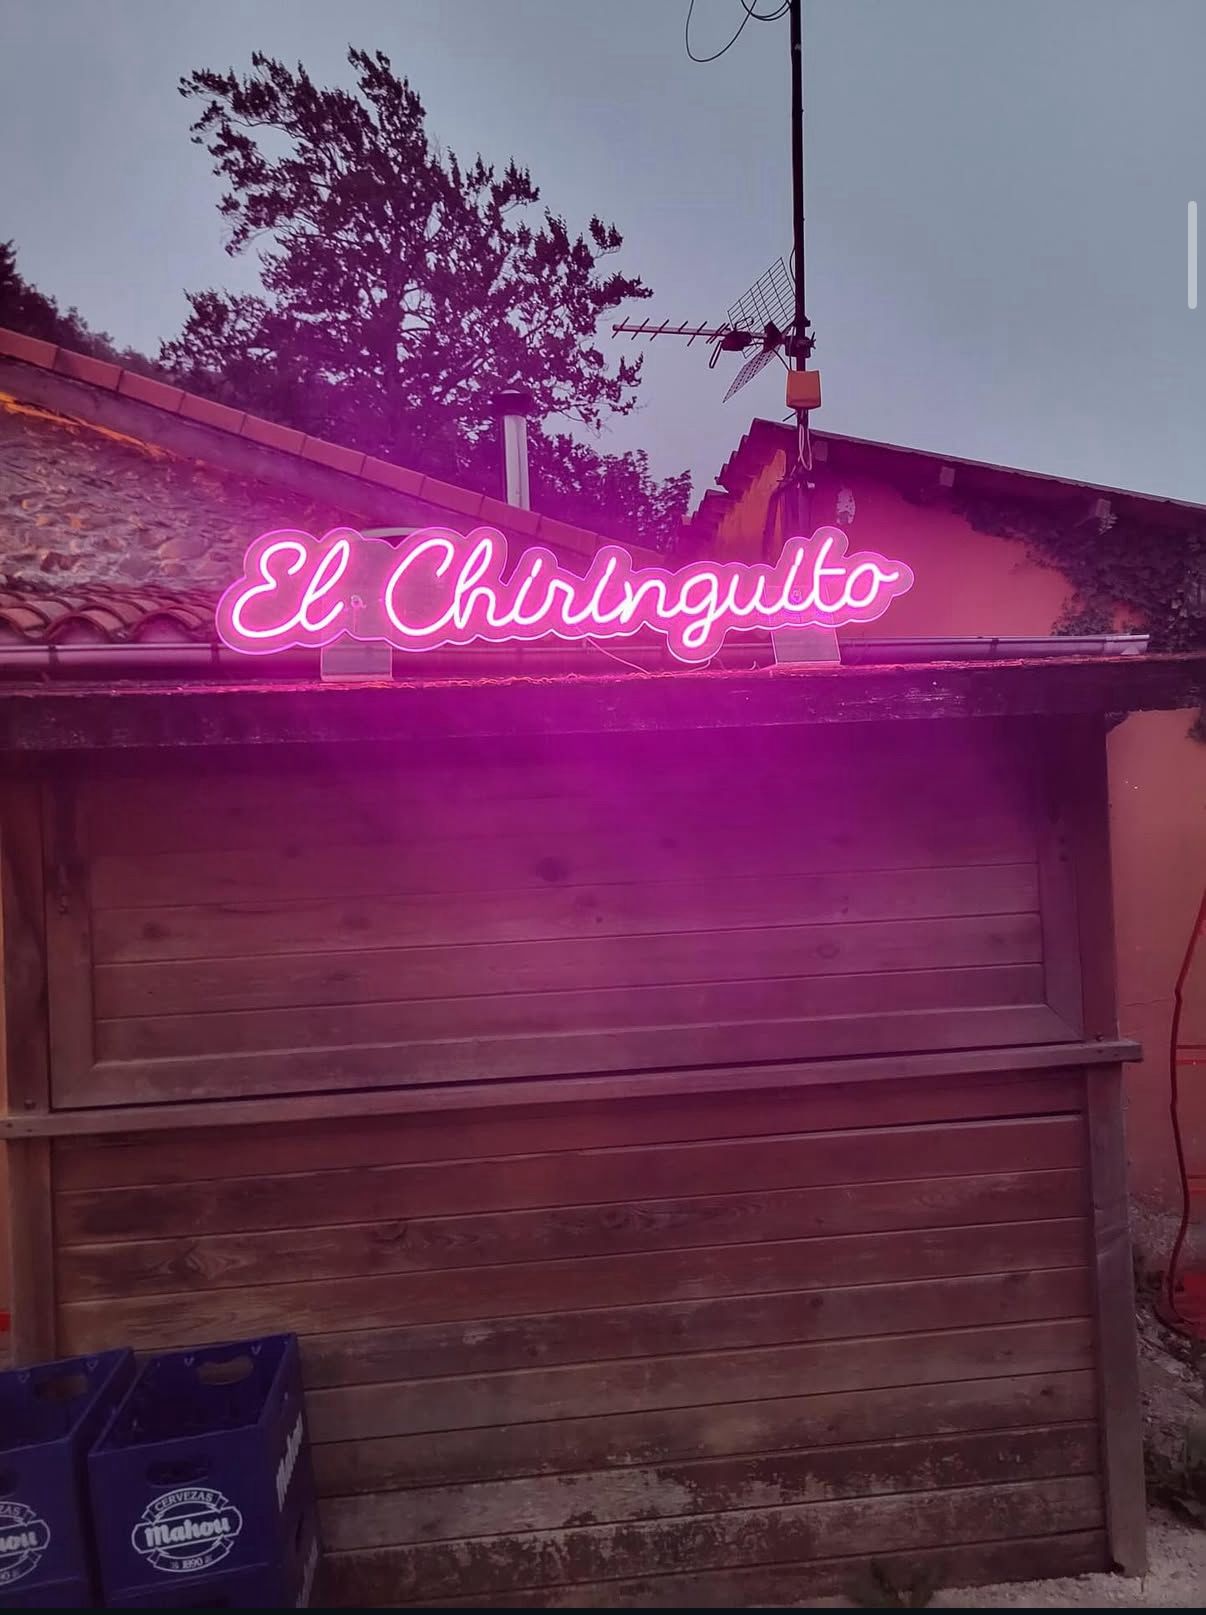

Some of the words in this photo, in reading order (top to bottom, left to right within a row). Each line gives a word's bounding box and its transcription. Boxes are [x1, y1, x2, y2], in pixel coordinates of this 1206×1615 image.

[232, 539, 350, 638] El
[385, 537, 900, 649] Chiringuito
[154, 1491, 215, 1512] CERVEZAS
[144, 1517, 231, 1548] Mahou
